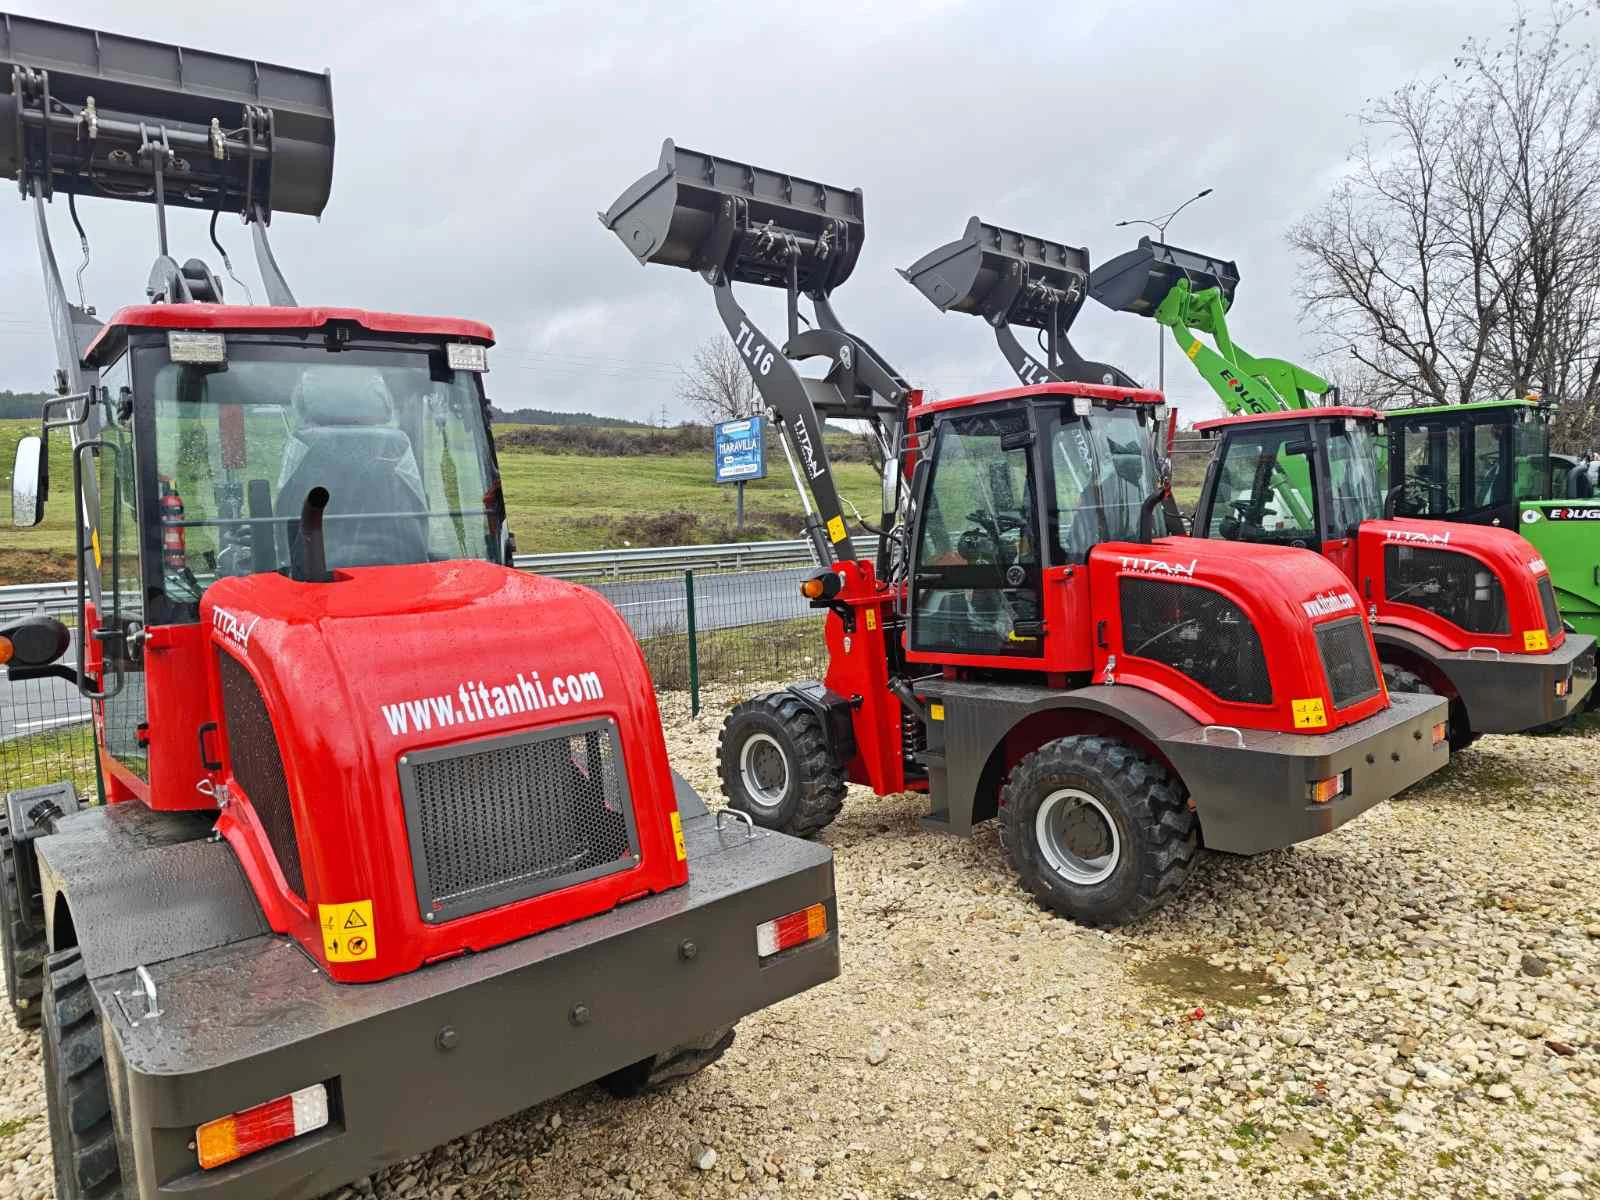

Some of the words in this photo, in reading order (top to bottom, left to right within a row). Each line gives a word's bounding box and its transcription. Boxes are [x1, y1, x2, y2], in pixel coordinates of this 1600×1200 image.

[735, 320, 774, 376] TL16
[719, 439, 757, 454] MARAVILLA
[795, 414, 826, 479] TITAN
[1382, 529, 1451, 544] TITAN
[1118, 556, 1198, 577] TITAN
[213, 604, 261, 648] TITAN
[381, 671, 605, 736] www.titanhi.com
